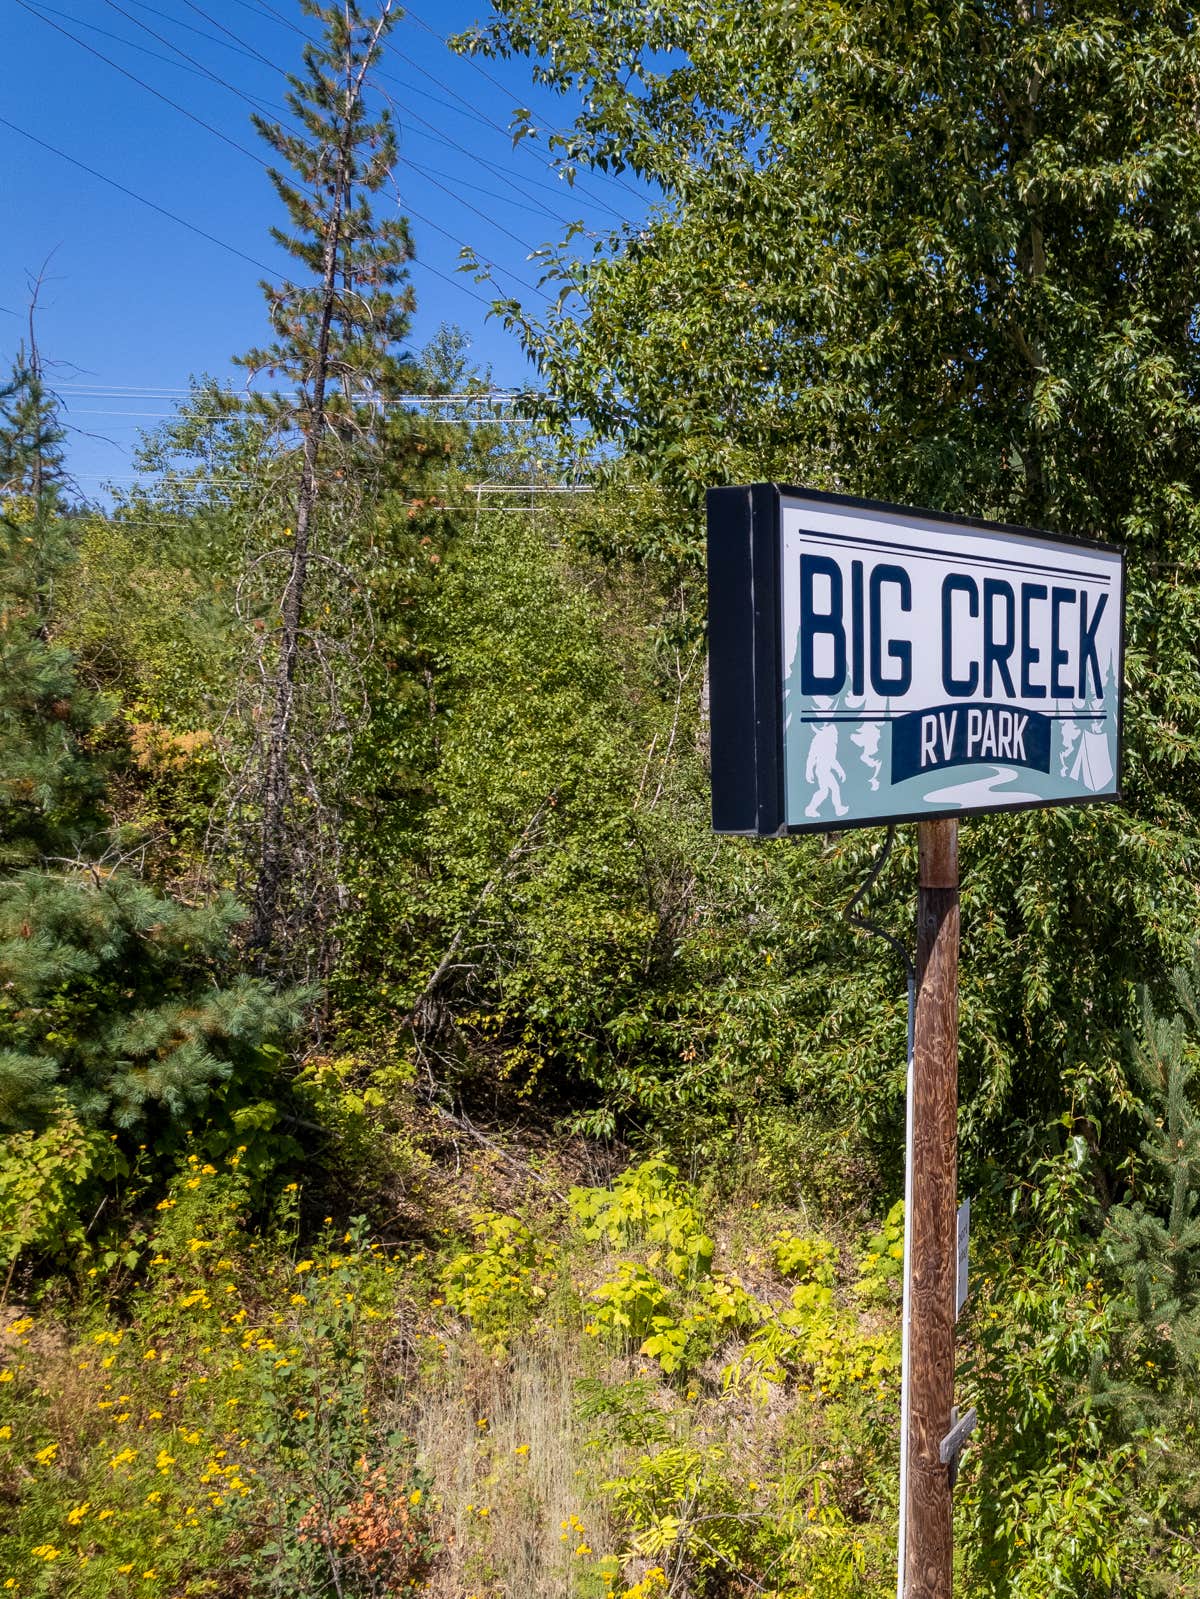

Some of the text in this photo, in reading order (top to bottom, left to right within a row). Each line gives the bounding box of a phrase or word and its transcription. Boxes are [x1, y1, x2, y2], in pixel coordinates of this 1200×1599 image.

[800, 553, 1109, 699] BIG CREEK
[920, 708, 1029, 767] RV PARK
